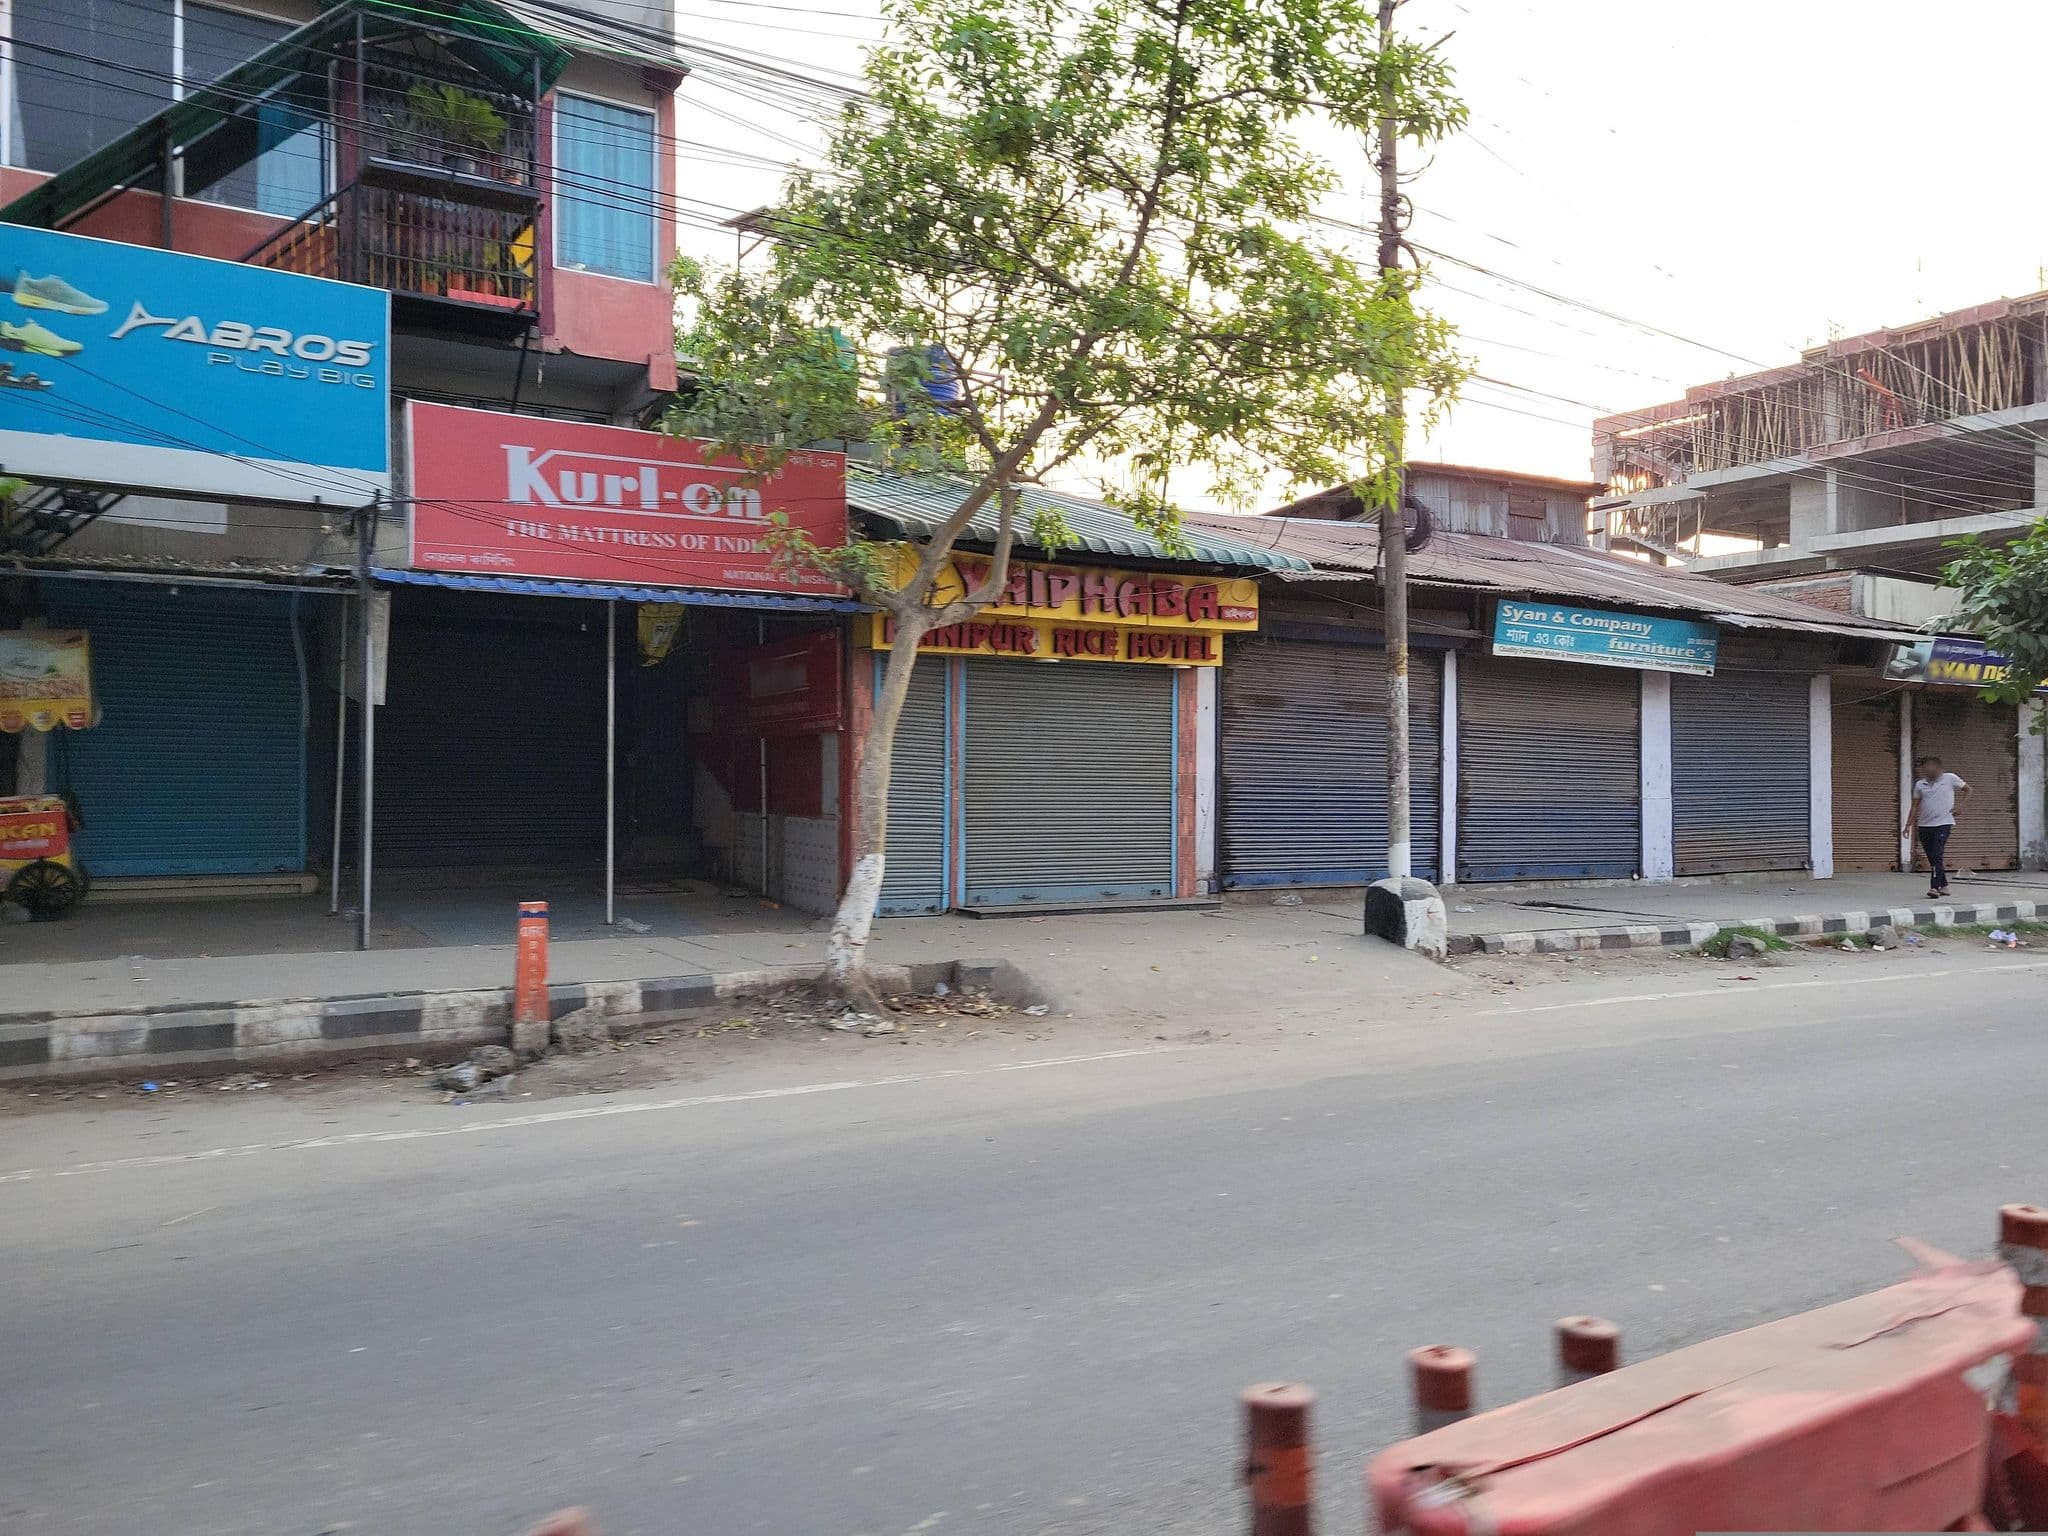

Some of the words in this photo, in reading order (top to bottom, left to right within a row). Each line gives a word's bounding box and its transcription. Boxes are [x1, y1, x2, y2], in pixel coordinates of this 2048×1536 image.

[161, 315, 376, 367] ABROS
[317, 367, 376, 389] BIG
[500, 443, 765, 520] Kurl-on
[506, 520, 553, 541] THE
[556, 524, 678, 550] MATTRESS
[680, 533, 711, 551] OF
[1502, 605, 1548, 622] Syan
[1551, 611, 1565, 624] &
[1570, 613, 1653, 637] Company
[1053, 627, 1119, 657] RICE
[1127, 631, 1218, 661] HOTEL
